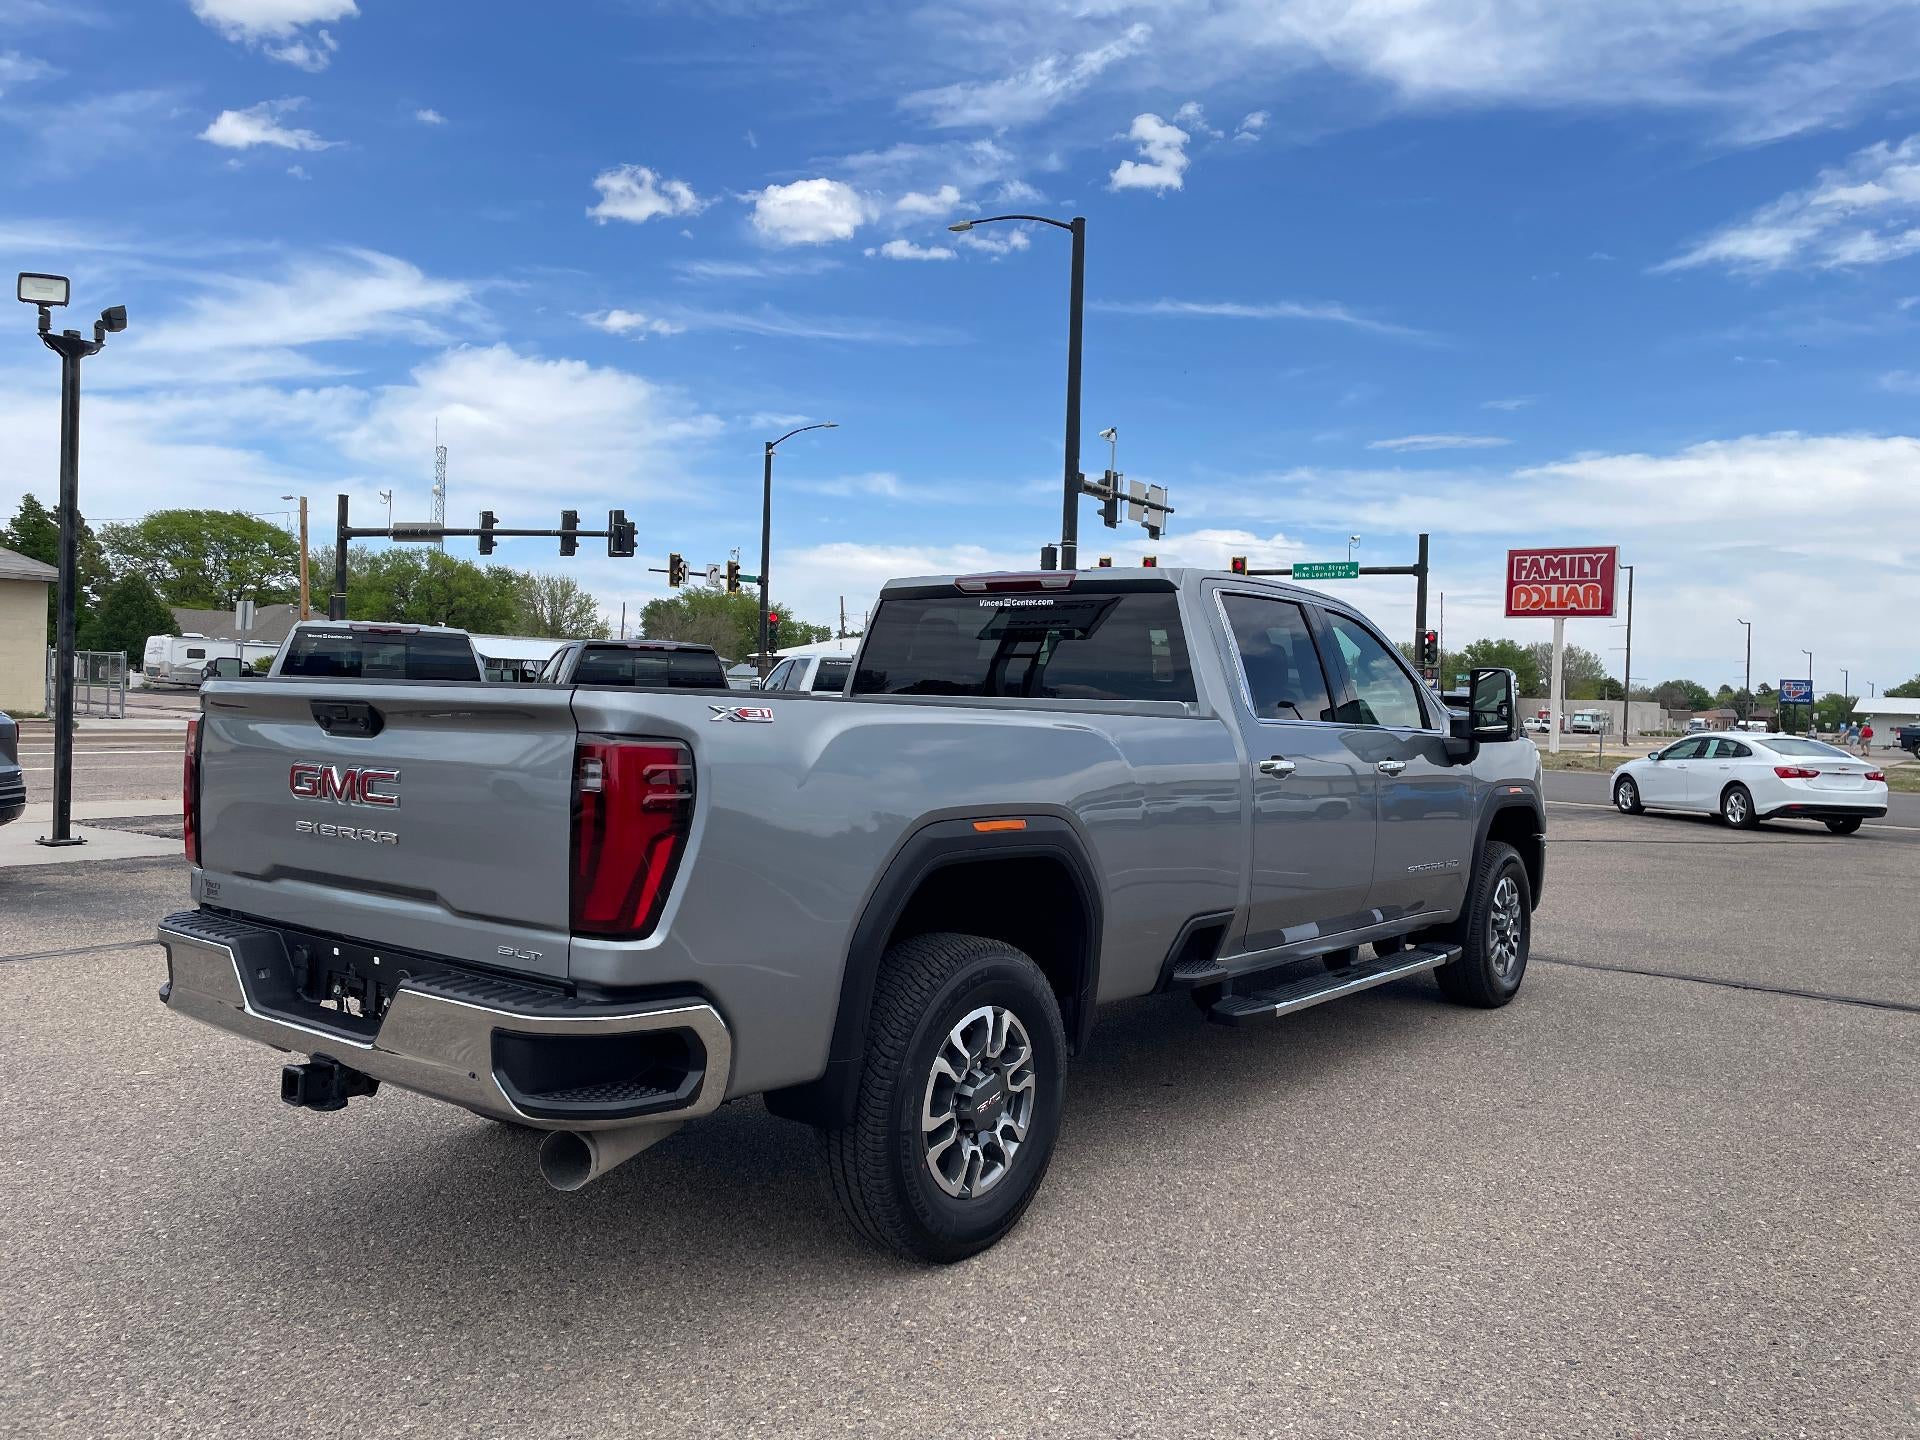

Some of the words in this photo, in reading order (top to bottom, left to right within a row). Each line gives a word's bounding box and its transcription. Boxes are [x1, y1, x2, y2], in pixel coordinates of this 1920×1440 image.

[1514, 553, 1608, 581] FAMILY
[1512, 583, 1602, 610] DOLLAR
[707, 705, 775, 723] X31
[289, 761, 401, 810] GMC
[295, 820, 399, 845] SIERRA
[497, 945, 543, 961] SLT
